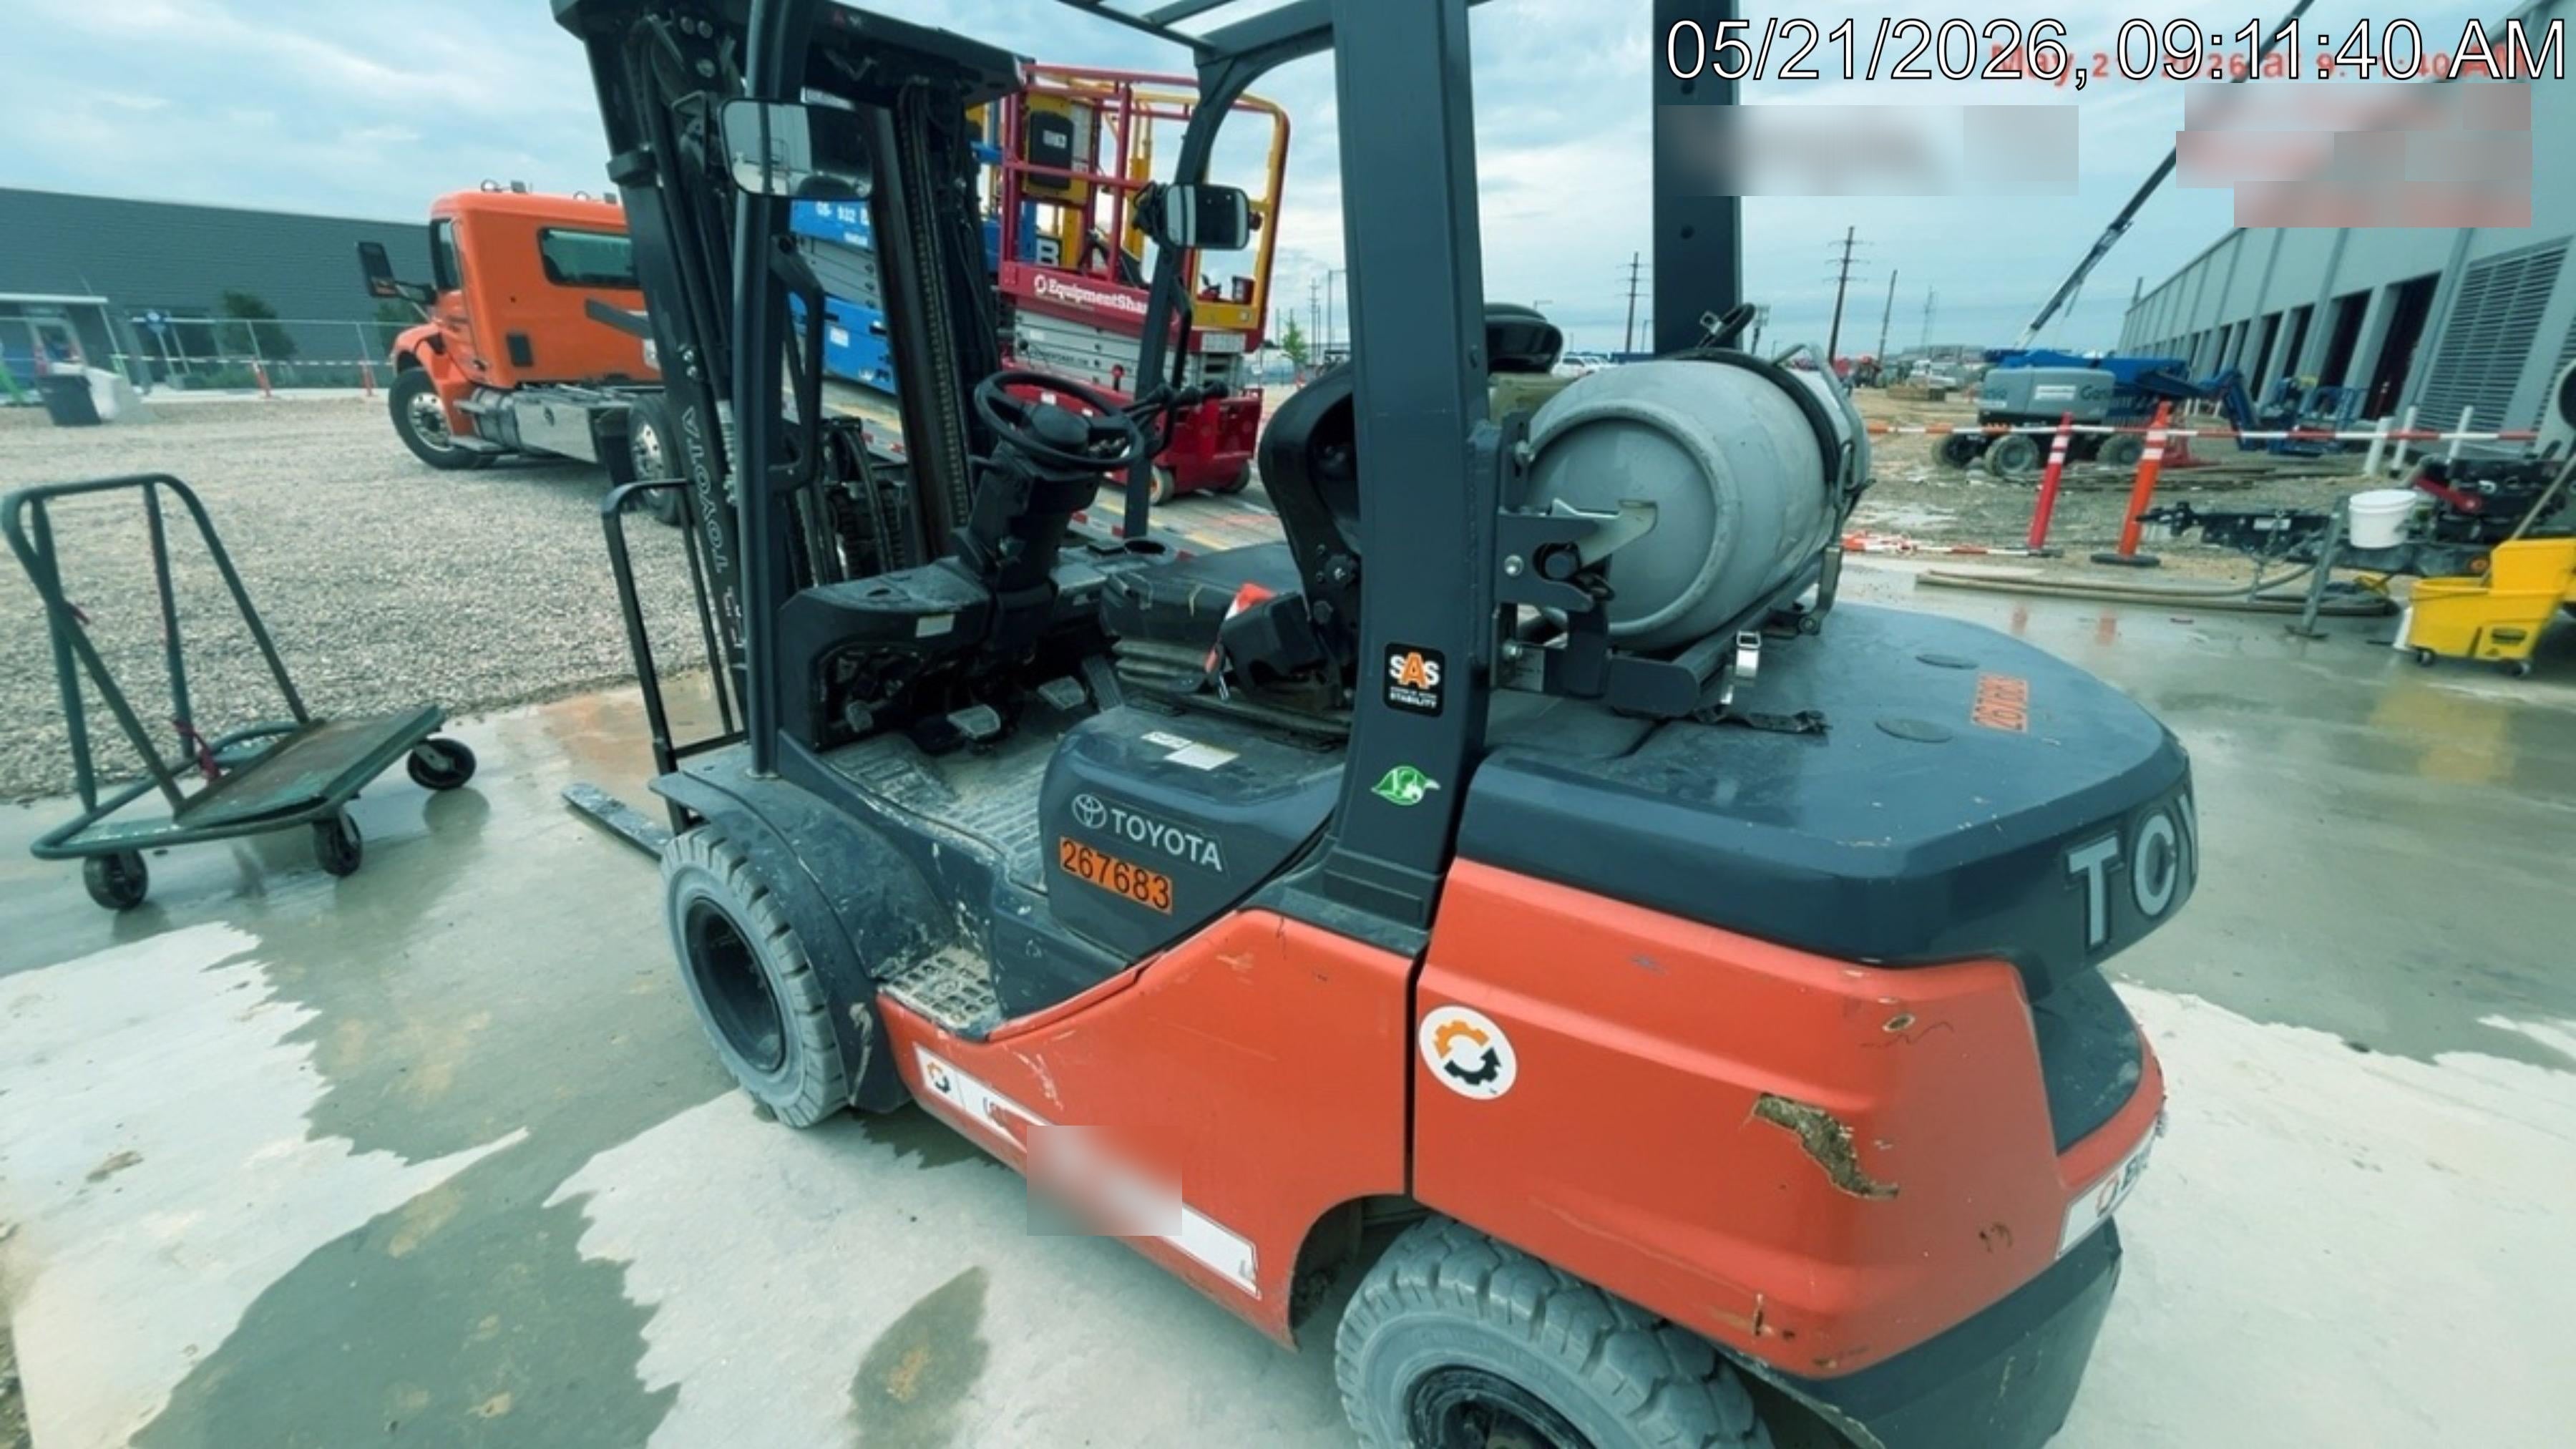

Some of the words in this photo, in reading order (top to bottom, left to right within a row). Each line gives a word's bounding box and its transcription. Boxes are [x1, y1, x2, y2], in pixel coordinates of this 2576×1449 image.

[681, 405, 729, 573] TOYOTA
[1390, 652, 1440, 689] SAS
[1110, 809, 1223, 872] TOYOTA
[1062, 839, 1170, 909] 267683
